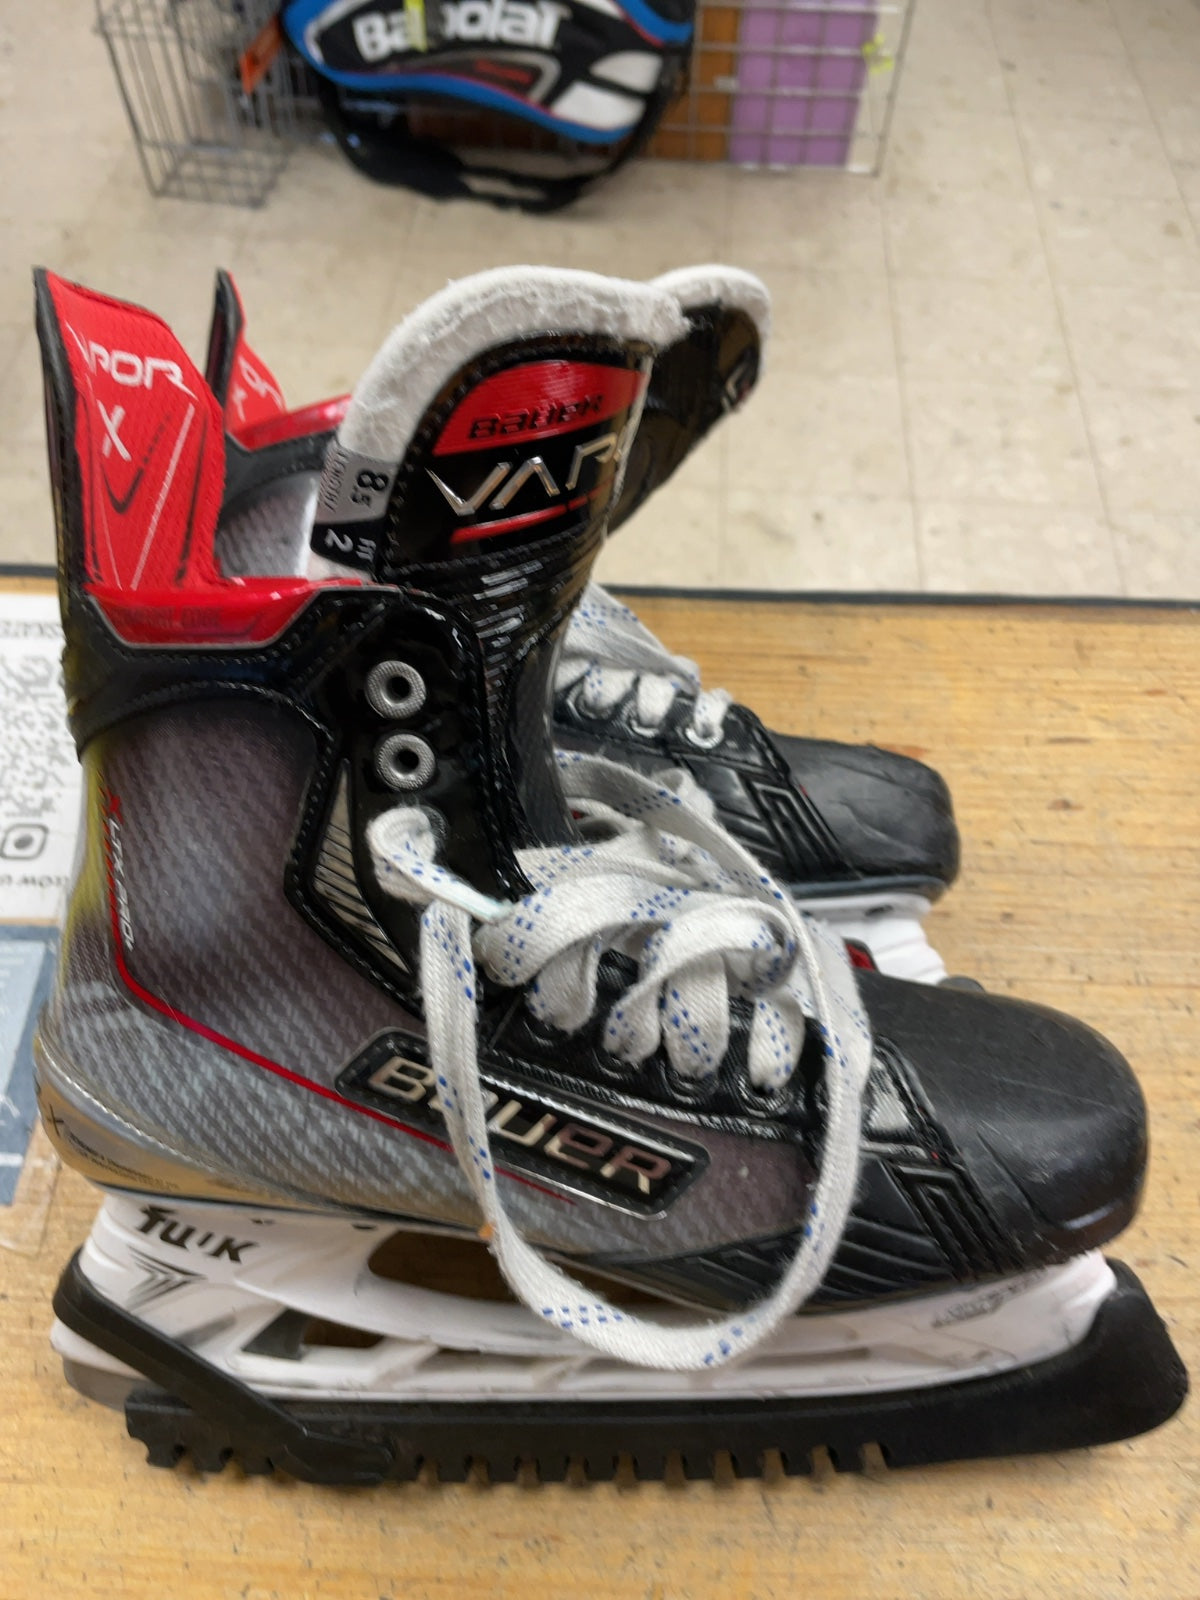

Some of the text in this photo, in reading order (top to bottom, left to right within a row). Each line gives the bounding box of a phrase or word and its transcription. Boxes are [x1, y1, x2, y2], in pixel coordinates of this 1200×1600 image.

[353, 0, 568, 63] Baolat
[423, 432, 624, 517] VAP
[325, 528, 354, 553] 2
[368, 1055, 672, 1195] BUER
